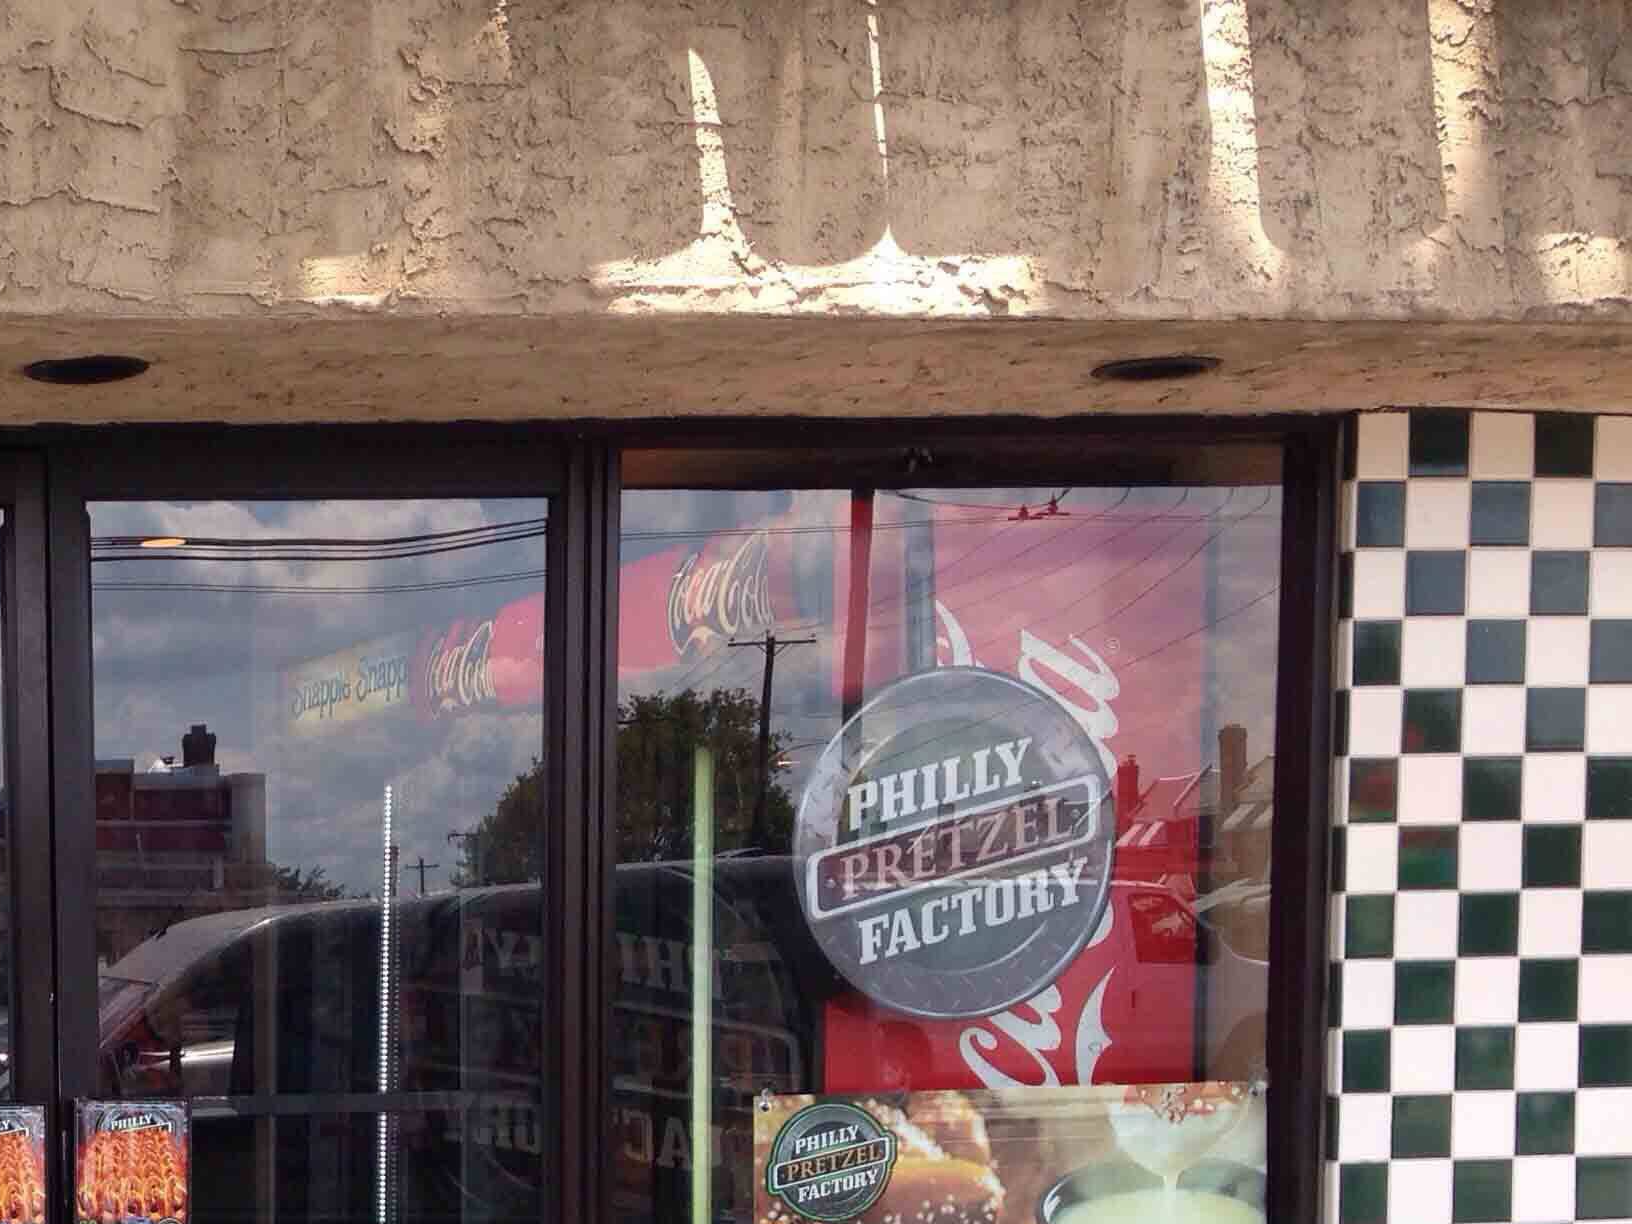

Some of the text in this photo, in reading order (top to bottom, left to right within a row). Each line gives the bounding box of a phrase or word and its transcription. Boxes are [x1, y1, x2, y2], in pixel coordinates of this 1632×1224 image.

[848, 736, 1034, 831] PHILLY
[840, 797, 1072, 901] PRETZEL
[857, 856, 1089, 966] FACTORY
[110, 1113, 154, 1131] PHILLY
[794, 1124, 860, 1155] PHILLY
[786, 1143, 882, 1182] PRETZEL
[798, 1168, 880, 1203] FACTORY
